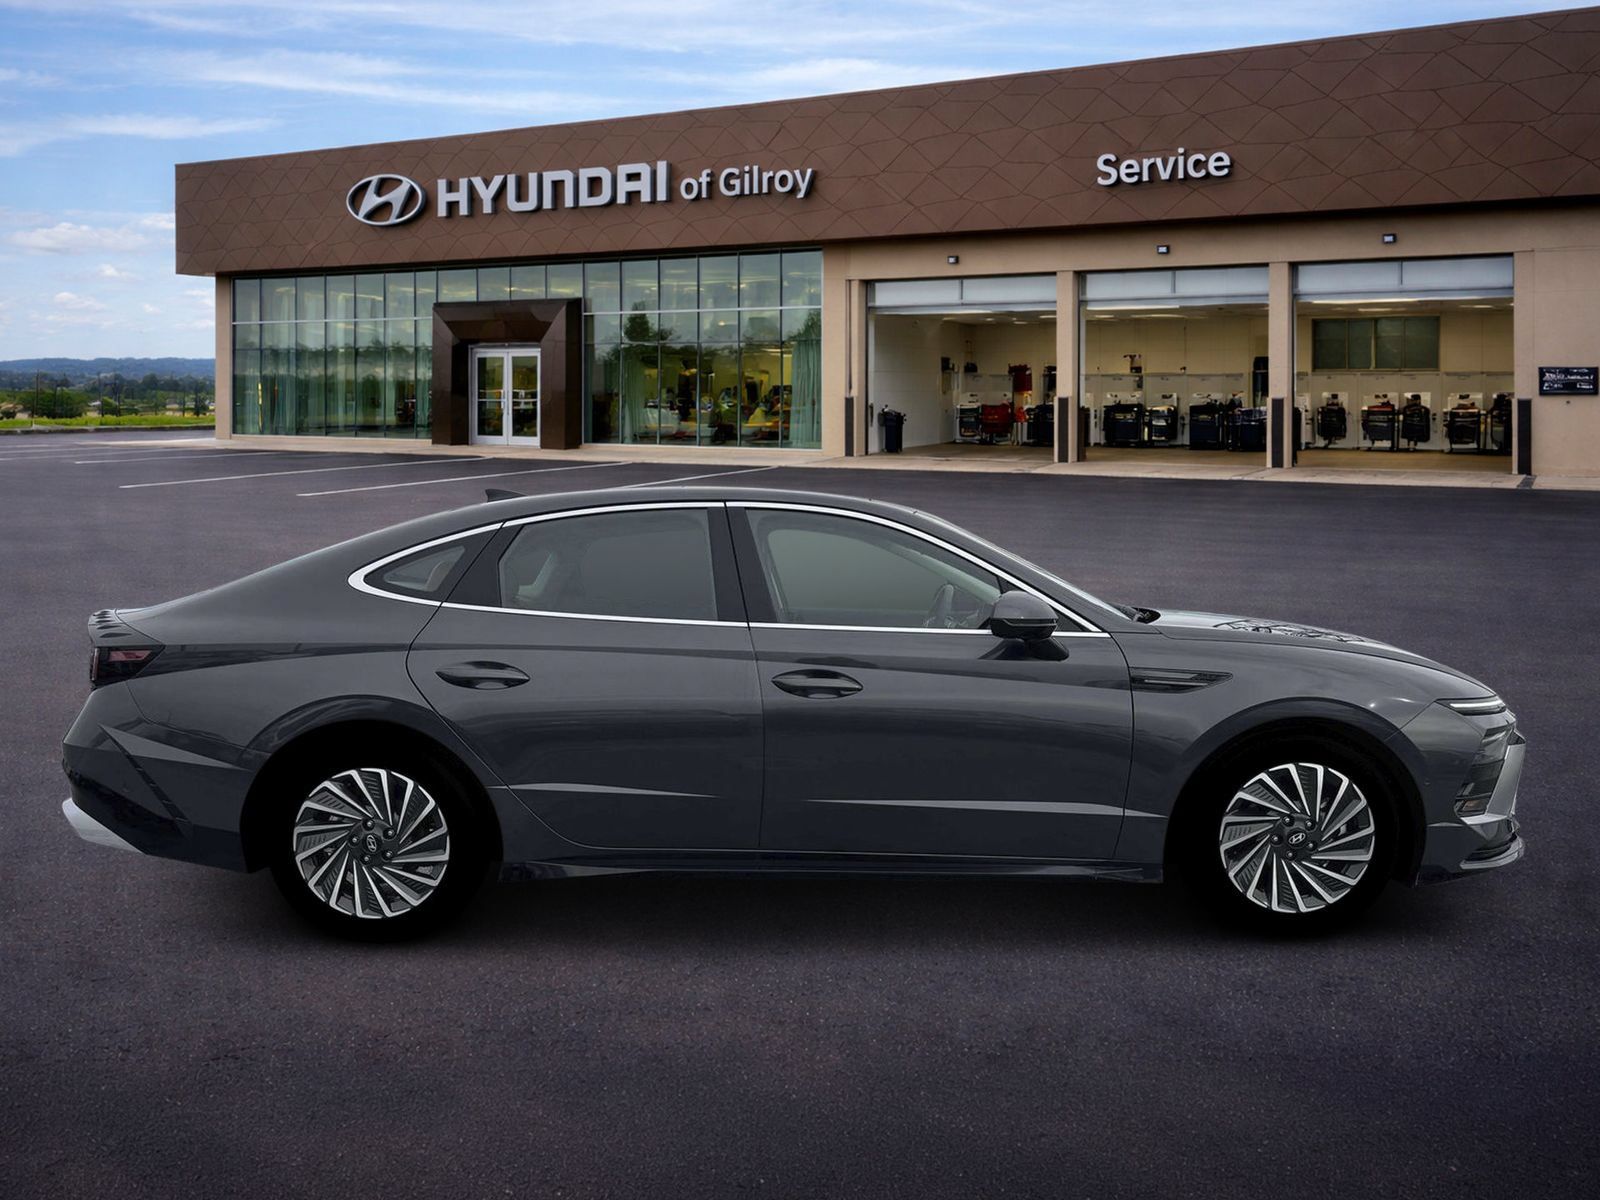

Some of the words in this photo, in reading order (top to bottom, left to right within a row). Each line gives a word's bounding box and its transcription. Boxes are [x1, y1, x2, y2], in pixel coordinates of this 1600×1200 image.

[437, 160, 668, 217] HYUNDAI
[679, 169, 711, 201] of
[718, 165, 813, 199] Gilroy
[1096, 147, 1231, 186] Service
